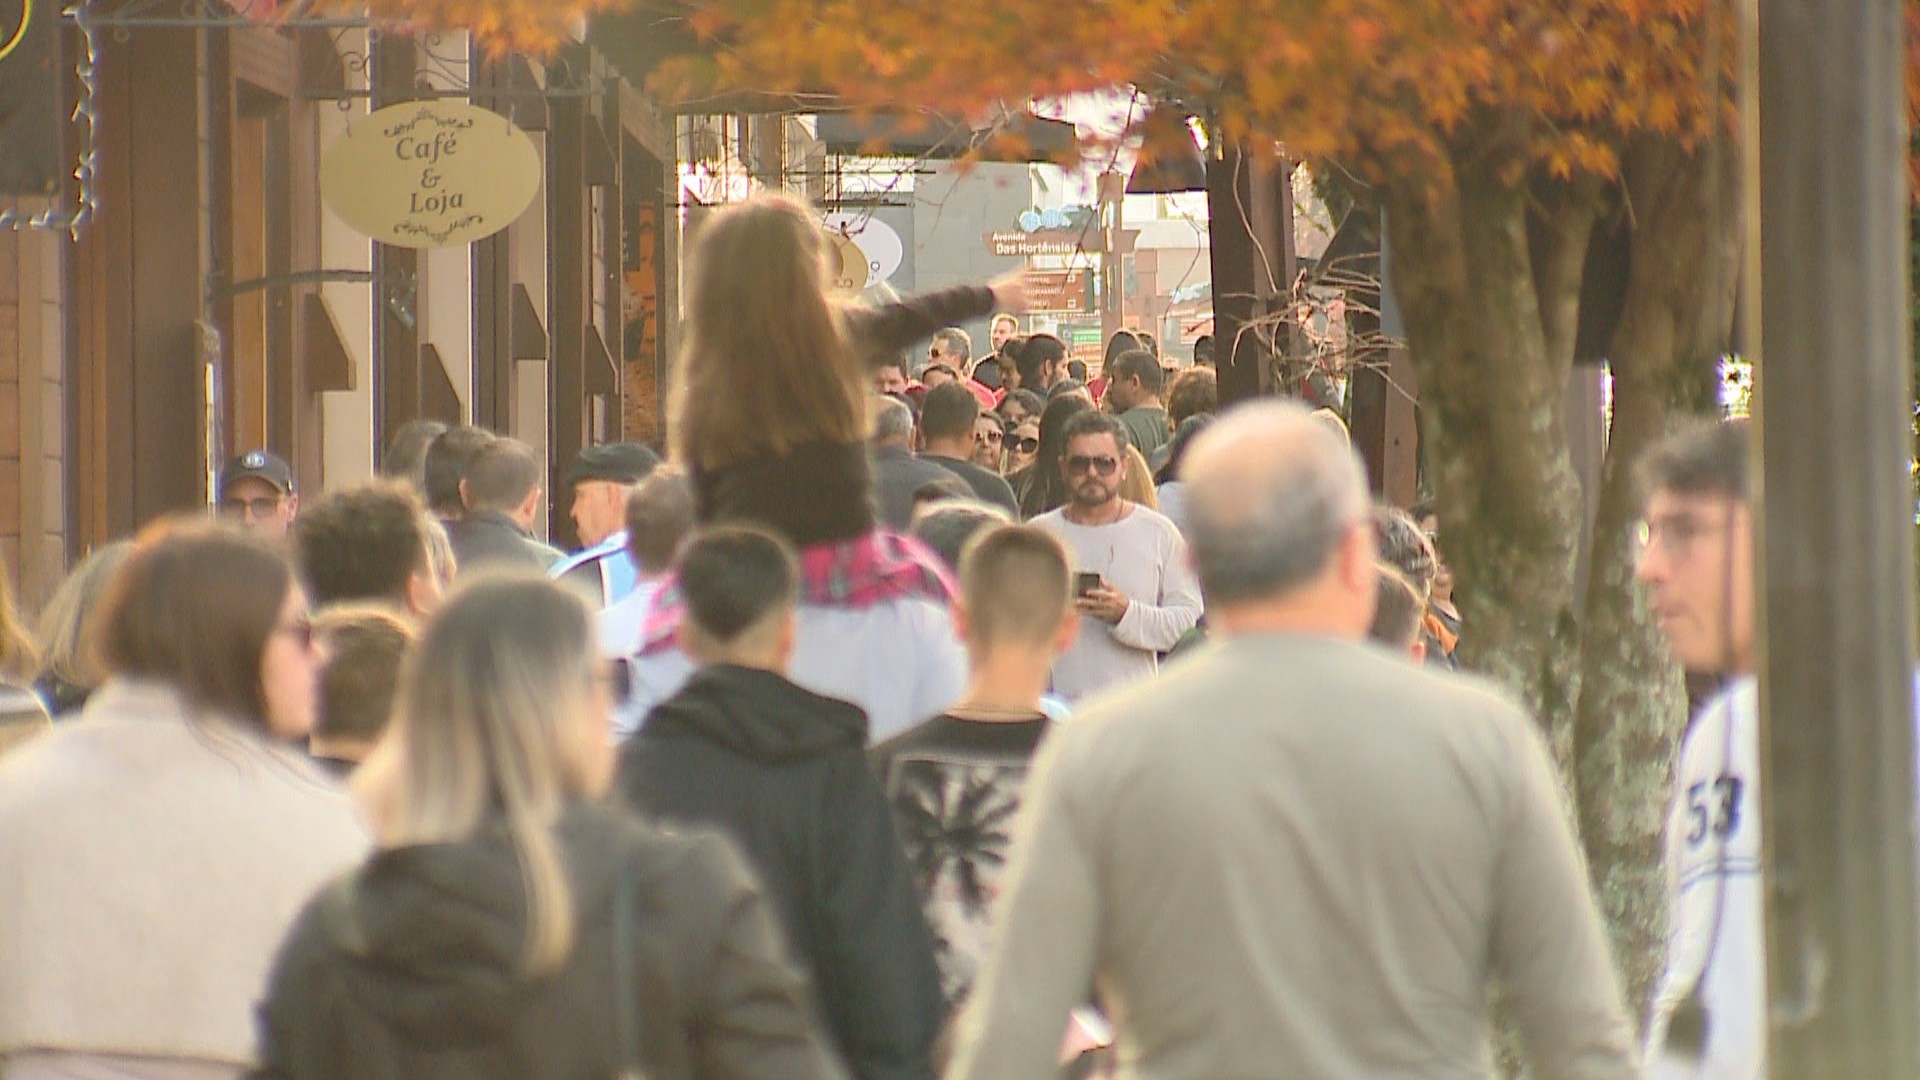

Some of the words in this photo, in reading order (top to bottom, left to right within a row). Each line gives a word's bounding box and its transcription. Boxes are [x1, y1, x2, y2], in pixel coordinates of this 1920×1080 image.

[395, 131, 457, 164] Café
[420, 168, 441, 188] &
[409, 189, 463, 216] Loja
[992, 232, 1026, 242] Avenida
[996, 243, 1016, 255] Das
[1018, 241, 1077, 255] Hortênsias
[1686, 774, 1743, 846] 53
